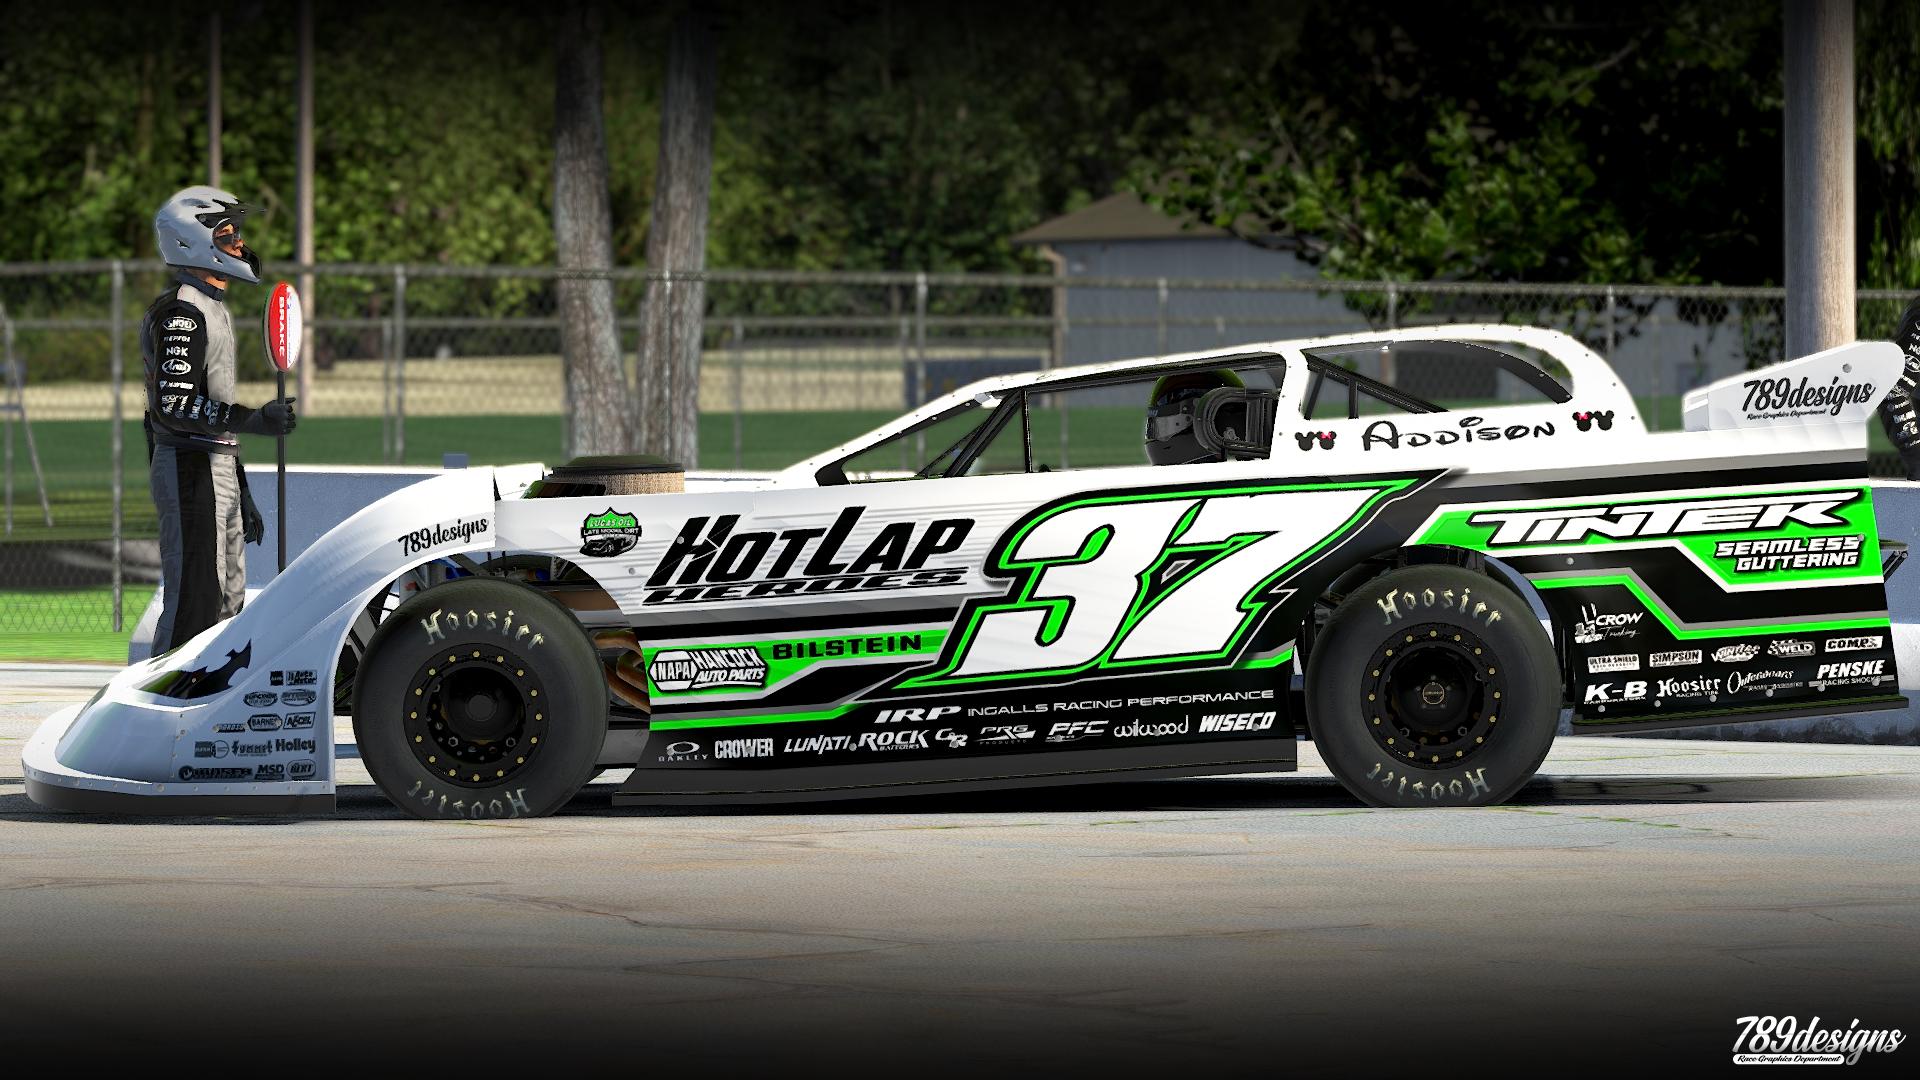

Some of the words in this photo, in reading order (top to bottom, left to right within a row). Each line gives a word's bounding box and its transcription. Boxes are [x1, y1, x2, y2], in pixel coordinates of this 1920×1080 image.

[166, 346, 189, 357] NGK
[1742, 375, 1877, 416] 789designs
[590, 519, 616, 527] LUCAS
[617, 518, 633, 526] OIL
[1470, 490, 1861, 546] TINTEK
[397, 518, 489, 557] 789designs
[1715, 535, 1860, 557] SEAMLESS
[1736, 551, 1859, 571] GUTTERING
[641, 572, 969, 606] HEROES
[950, 486, 1395, 681] 37
[1376, 587, 1502, 627] Hoosier
[1595, 611, 1644, 626] CROW
[772, 633, 922, 661] BILSTEIN
[1651, 650, 1700, 663] SIMPSON
[1779, 643, 1813, 654] WELD
[688, 647, 765, 670] HANCOCK
[1589, 656, 1612, 665] ULTRA
[1613, 654, 1638, 663] SHIELD
[657, 661, 691, 680] NAPA
[694, 669, 728, 683] AUTO
[728, 667, 766, 681] PARTS
[1816, 659, 1886, 680] PENSKE
[1584, 680, 1648, 702] K-B
[1655, 674, 1722, 698] Hoosier
[1821, 678, 1850, 687] RACING
[967, 703, 1048, 717] INGALLS
[1053, 698, 1123, 712] RACING
[1127, 689, 1275, 707] PERFORMANCE
[874, 705, 962, 724] IRP
[1198, 711, 1277, 734] WISECO
[979, 724, 1031, 738] PRG
[1048, 719, 1111, 736] PFC
[1113, 714, 1190, 738] wilwood
[275, 738, 316, 755] Holley
[714, 737, 775, 759] CROWER
[783, 734, 852, 755] LUNATI
[857, 729, 931, 751] ROCK
[258, 763, 285, 774] MSD
[658, 753, 710, 763] OAKLEY
